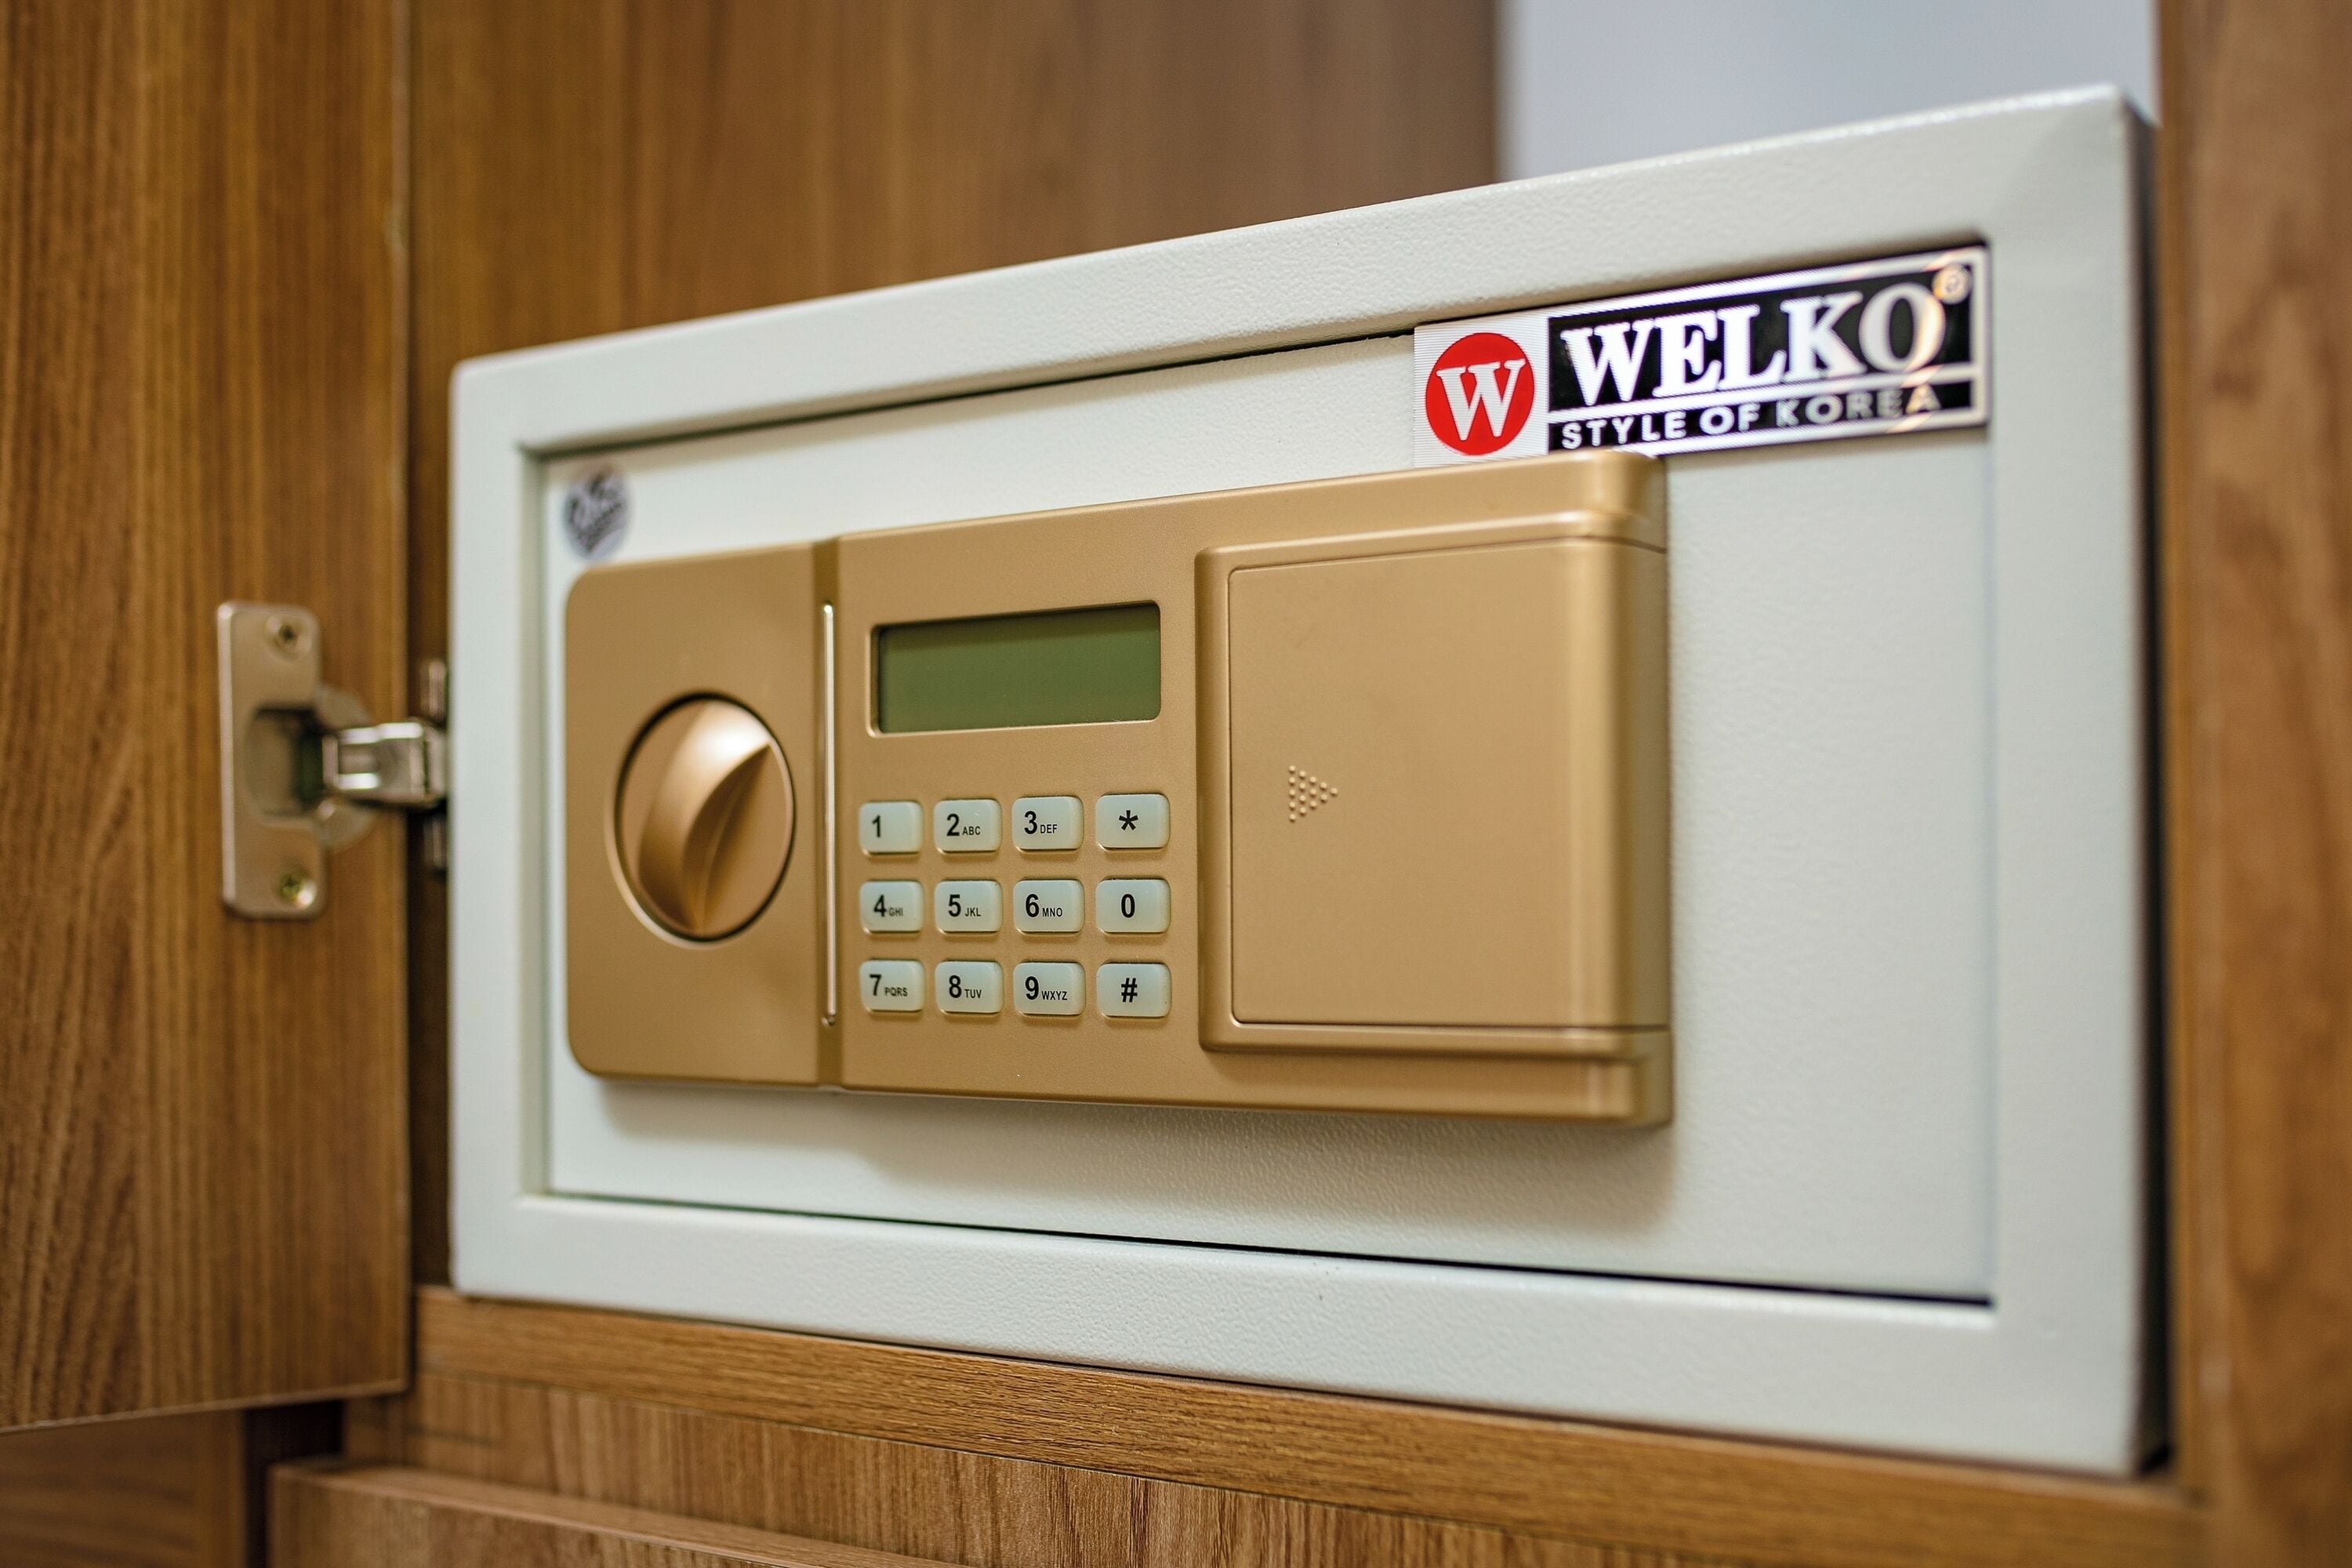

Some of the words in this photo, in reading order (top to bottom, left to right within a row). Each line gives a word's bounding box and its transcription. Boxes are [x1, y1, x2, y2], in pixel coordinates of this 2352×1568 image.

[1559, 281, 1946, 407] WELKO
[1436, 359, 1526, 441] W
[1561, 409, 1687, 450] STYLE
[1698, 402, 1761, 436] OF
[1775, 383, 1942, 427] KOREA
[871, 815, 882, 838] 1
[946, 813, 960, 837] 2
[962, 826, 981, 837] ABC
[1023, 810, 1038, 835] 3
[1040, 823, 1058, 834] DEF
[873, 894, 887, 918] 4
[888, 907, 904, 917] GHI
[947, 894, 961, 917] 5
[964, 907, 982, 917] JKL
[1025, 893, 1040, 918] 6
[1042, 907, 1063, 918] MNO
[1120, 893, 1136, 919] 0
[869, 974, 883, 997] 7
[884, 986, 908, 997] PQRS
[948, 975, 962, 999] 8
[964, 989, 982, 1000] TUV
[1025, 975, 1040, 1001] 9
[1041, 990, 1068, 1001] WXYZ
